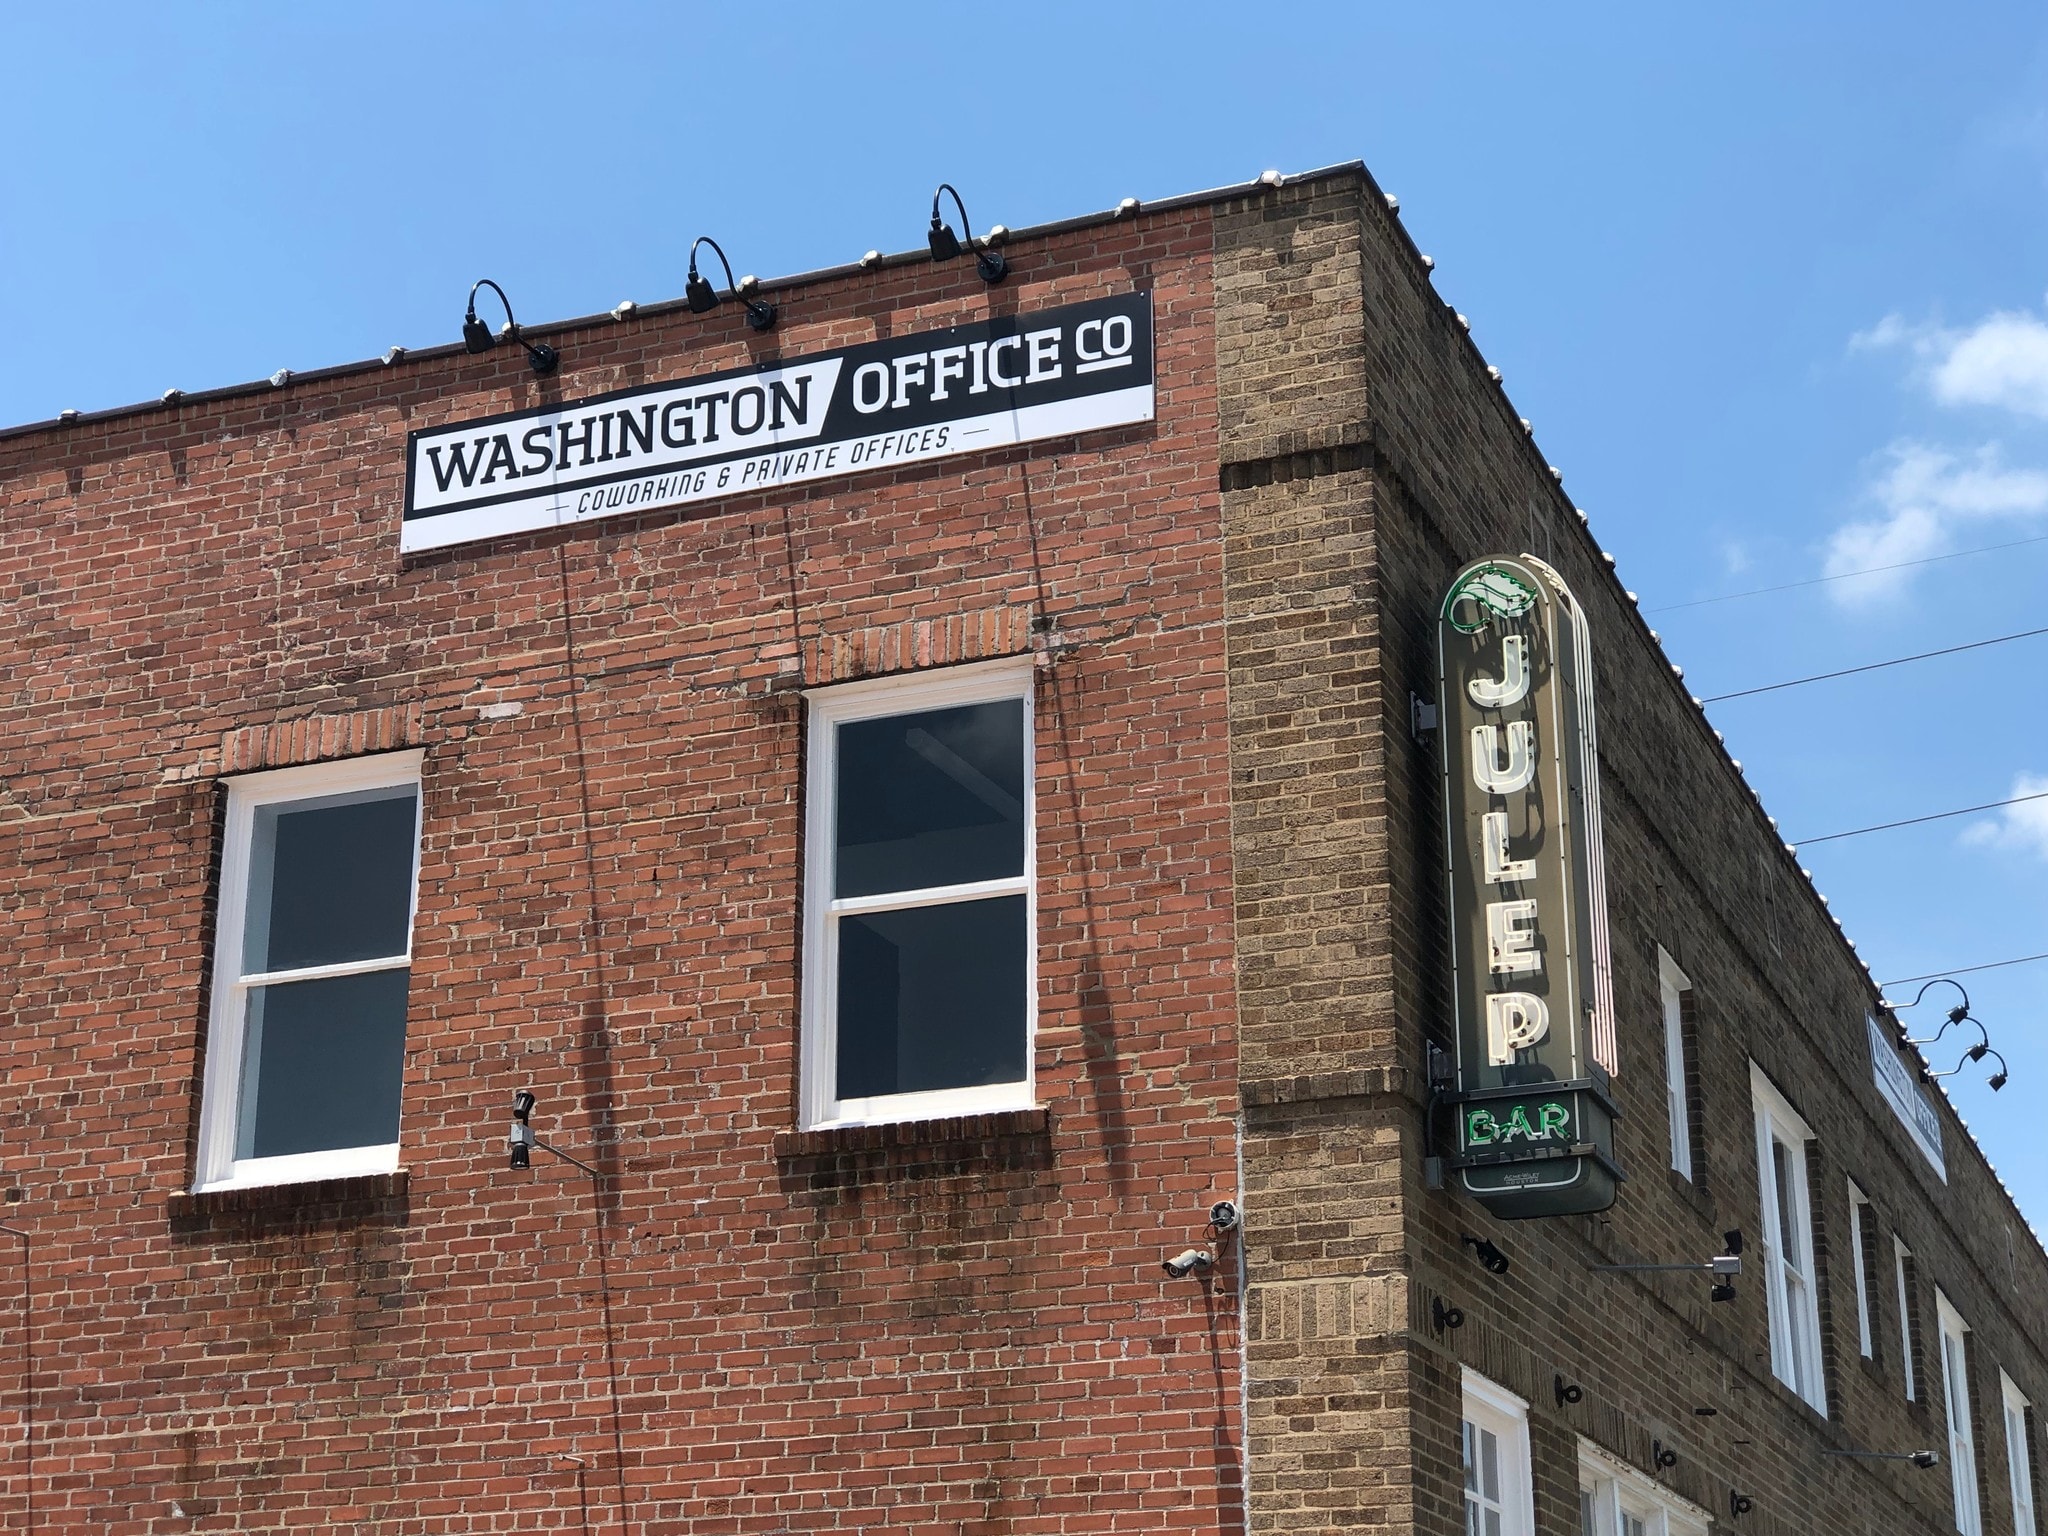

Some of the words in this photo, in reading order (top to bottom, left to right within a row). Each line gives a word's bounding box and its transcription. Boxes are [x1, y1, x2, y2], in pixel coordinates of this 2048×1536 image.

[426, 375, 812, 492] WASHINGTON
[852, 327, 1062, 414] OFFICE
[1075, 315, 1133, 361] CO
[578, 471, 706, 514] COWORKING
[717, 467, 730, 489] &
[742, 446, 840, 484] PRIVATE
[850, 426, 950, 464] OFFICES
[1468, 634, 1549, 1067] JULEP
[1467, 1103, 1570, 1146] BAR
